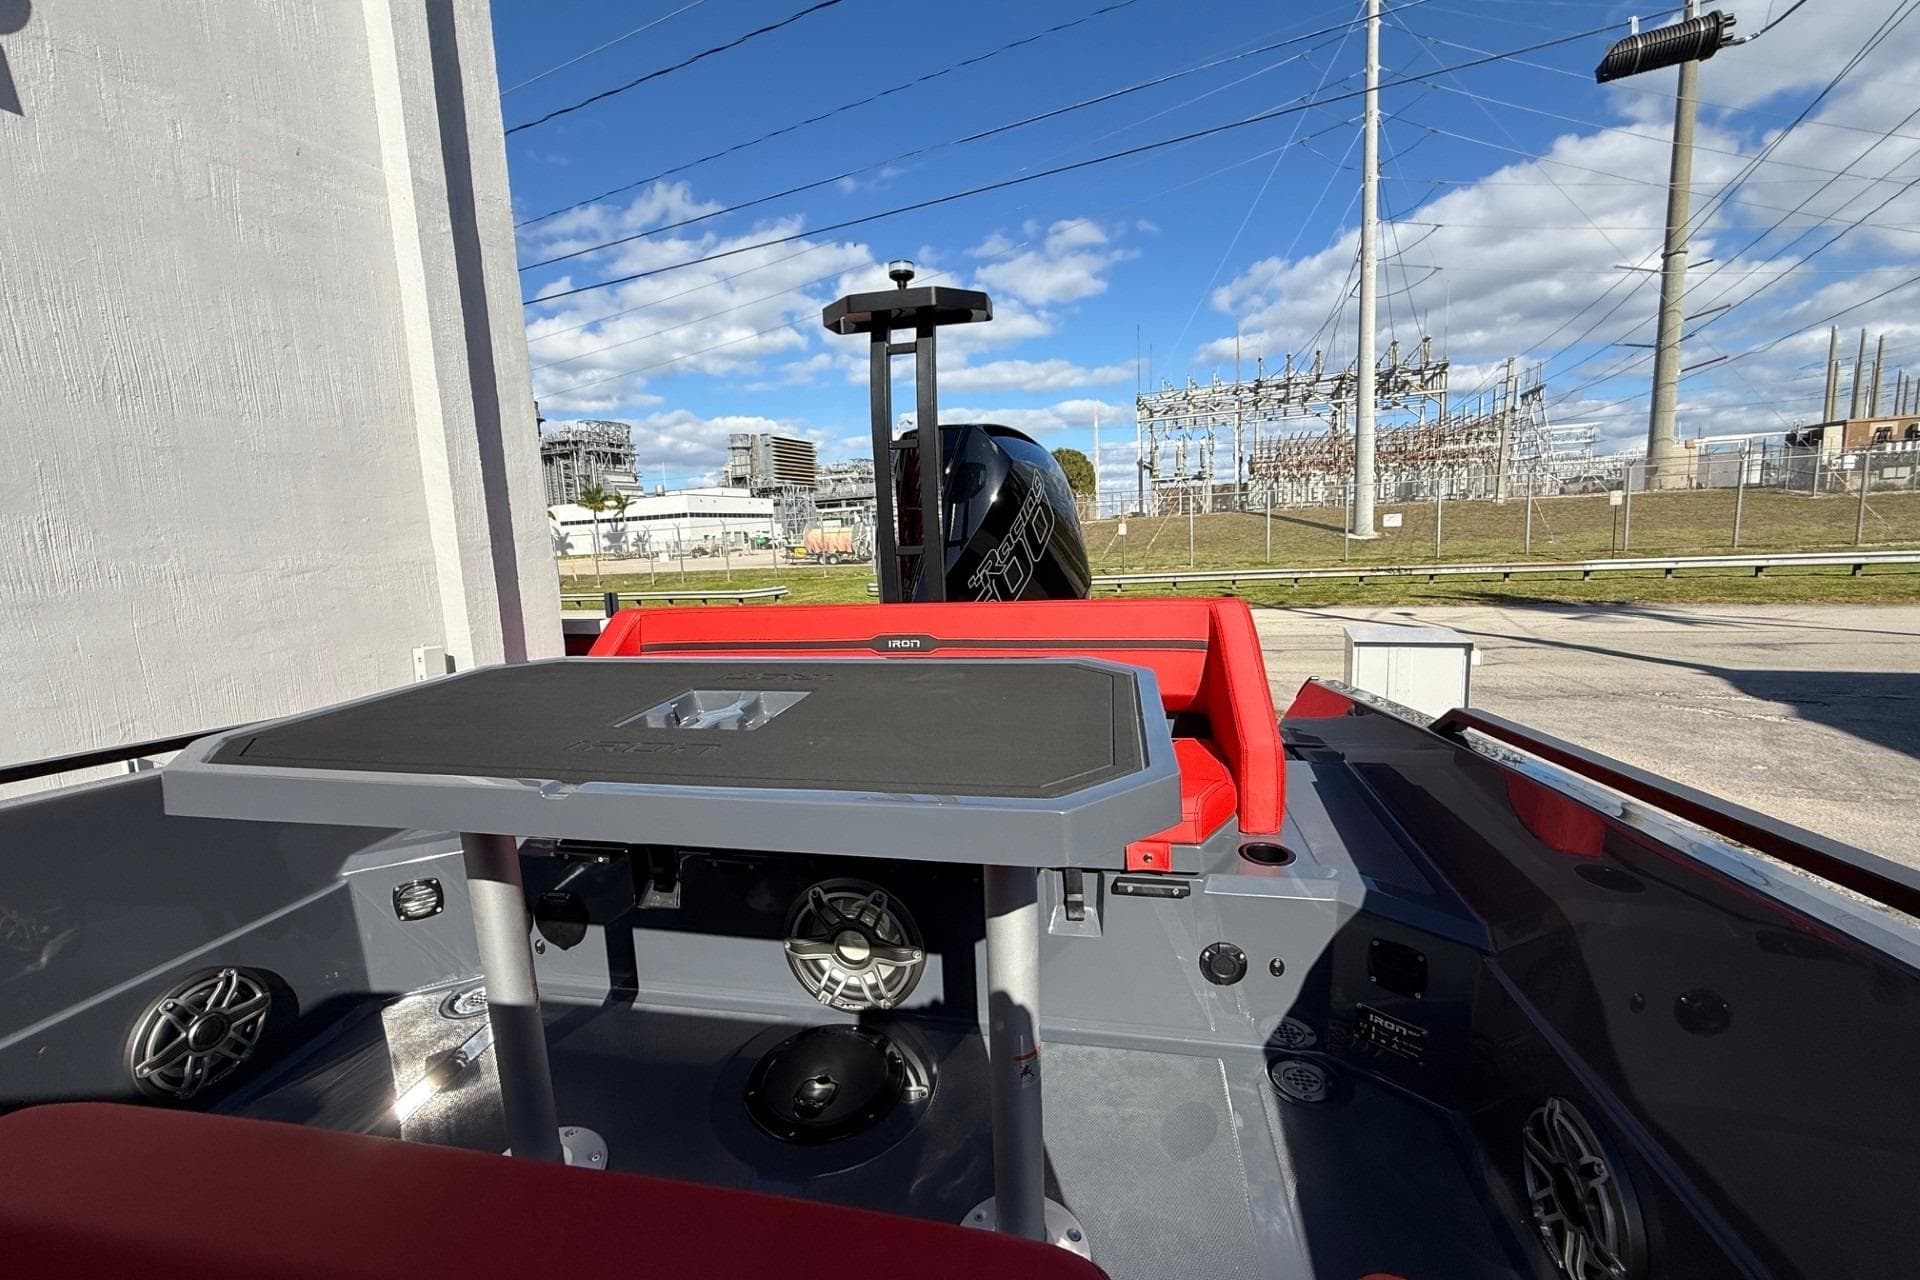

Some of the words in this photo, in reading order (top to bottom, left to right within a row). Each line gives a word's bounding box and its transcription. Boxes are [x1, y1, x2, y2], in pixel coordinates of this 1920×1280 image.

[974, 469, 1045, 580] Racing
[975, 490, 1055, 602] 00
[887, 639, 921, 648] IRON
[1369, 1013, 1408, 1036] IRON
